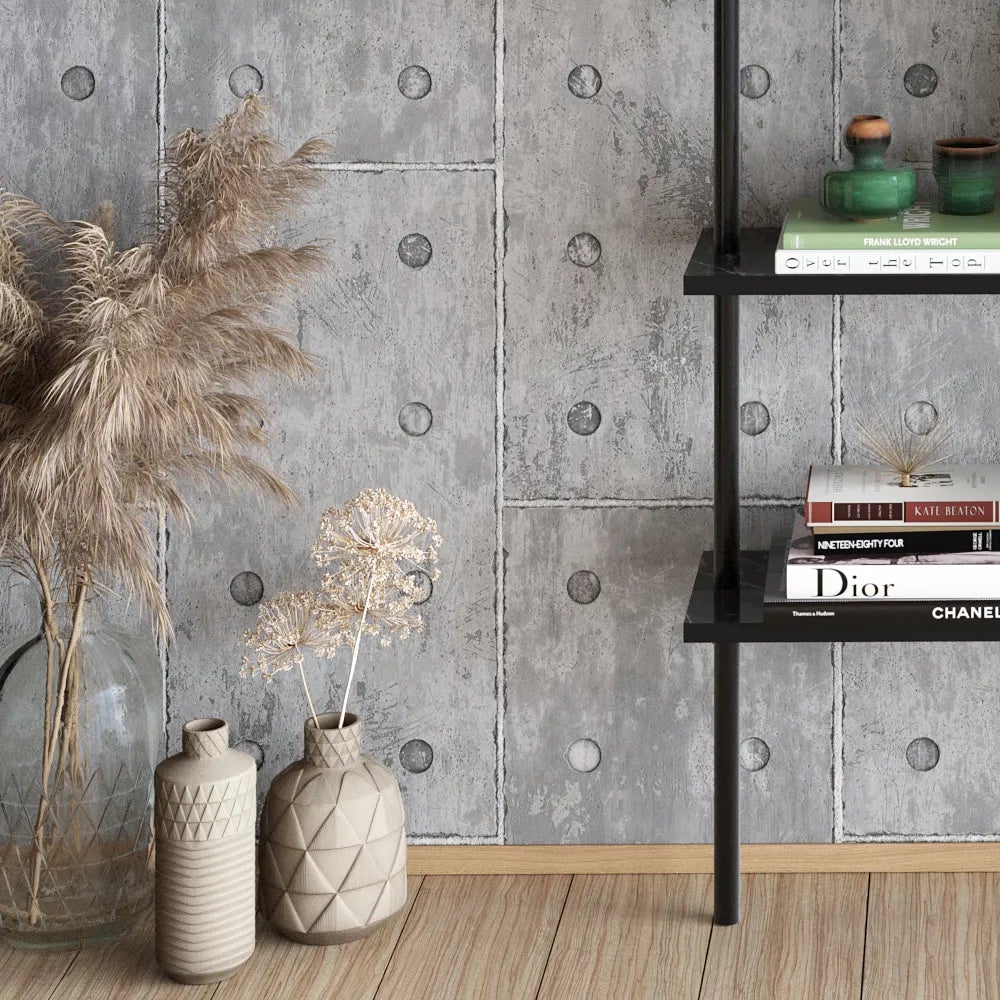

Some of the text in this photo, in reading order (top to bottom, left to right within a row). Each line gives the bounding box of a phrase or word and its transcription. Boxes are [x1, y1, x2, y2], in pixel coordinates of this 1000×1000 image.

[863, 238, 958, 246] FRANK LLOYD WRIGHT
[785, 257, 982, 269] Over the Top
[914, 505, 985, 516] KATE BEATON
[818, 538, 905, 550] NINETEEN-EIGHTY FOUR
[811, 567, 895, 597] Dior
